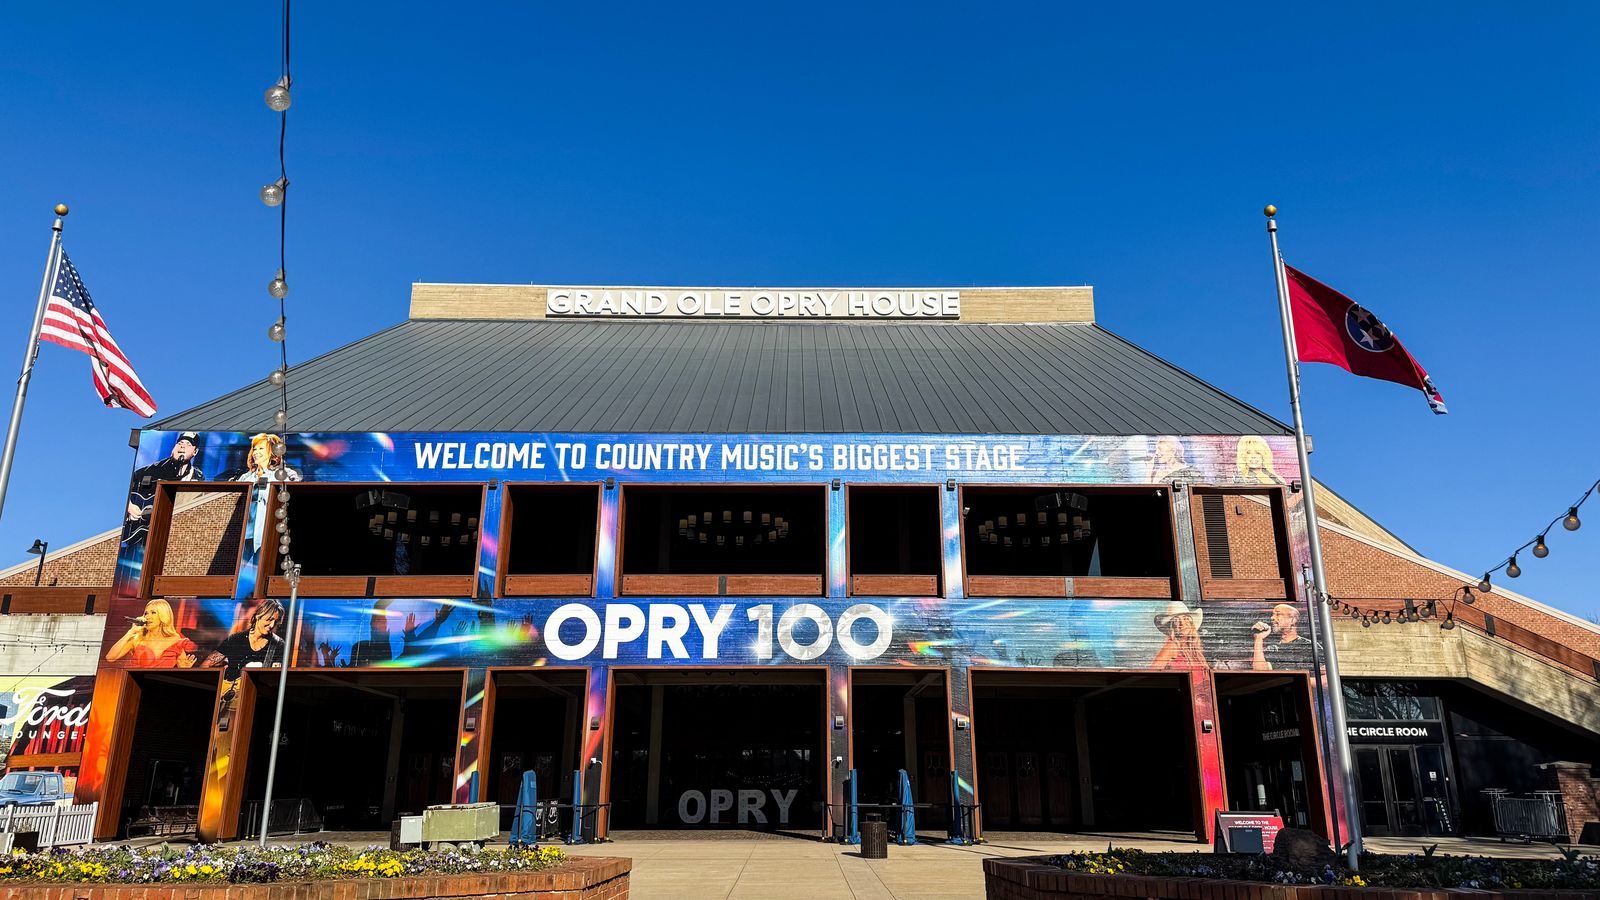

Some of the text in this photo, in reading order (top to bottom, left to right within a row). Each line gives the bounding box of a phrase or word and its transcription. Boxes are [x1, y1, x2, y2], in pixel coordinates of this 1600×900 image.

[547, 291, 960, 316] GRAND OLE OPRY HOUSE
[415, 442, 1025, 471] WELCOME TO COUNTRY MUSIC'S BIGGEST STAGE
[543, 603, 893, 661] OPRY 100
[0, 686, 92, 727] Ford
[3, 730, 78, 739] LOUNGE
[1346, 727, 1428, 736] HE CIRCLE ROOM
[678, 789, 798, 824] OPRY
